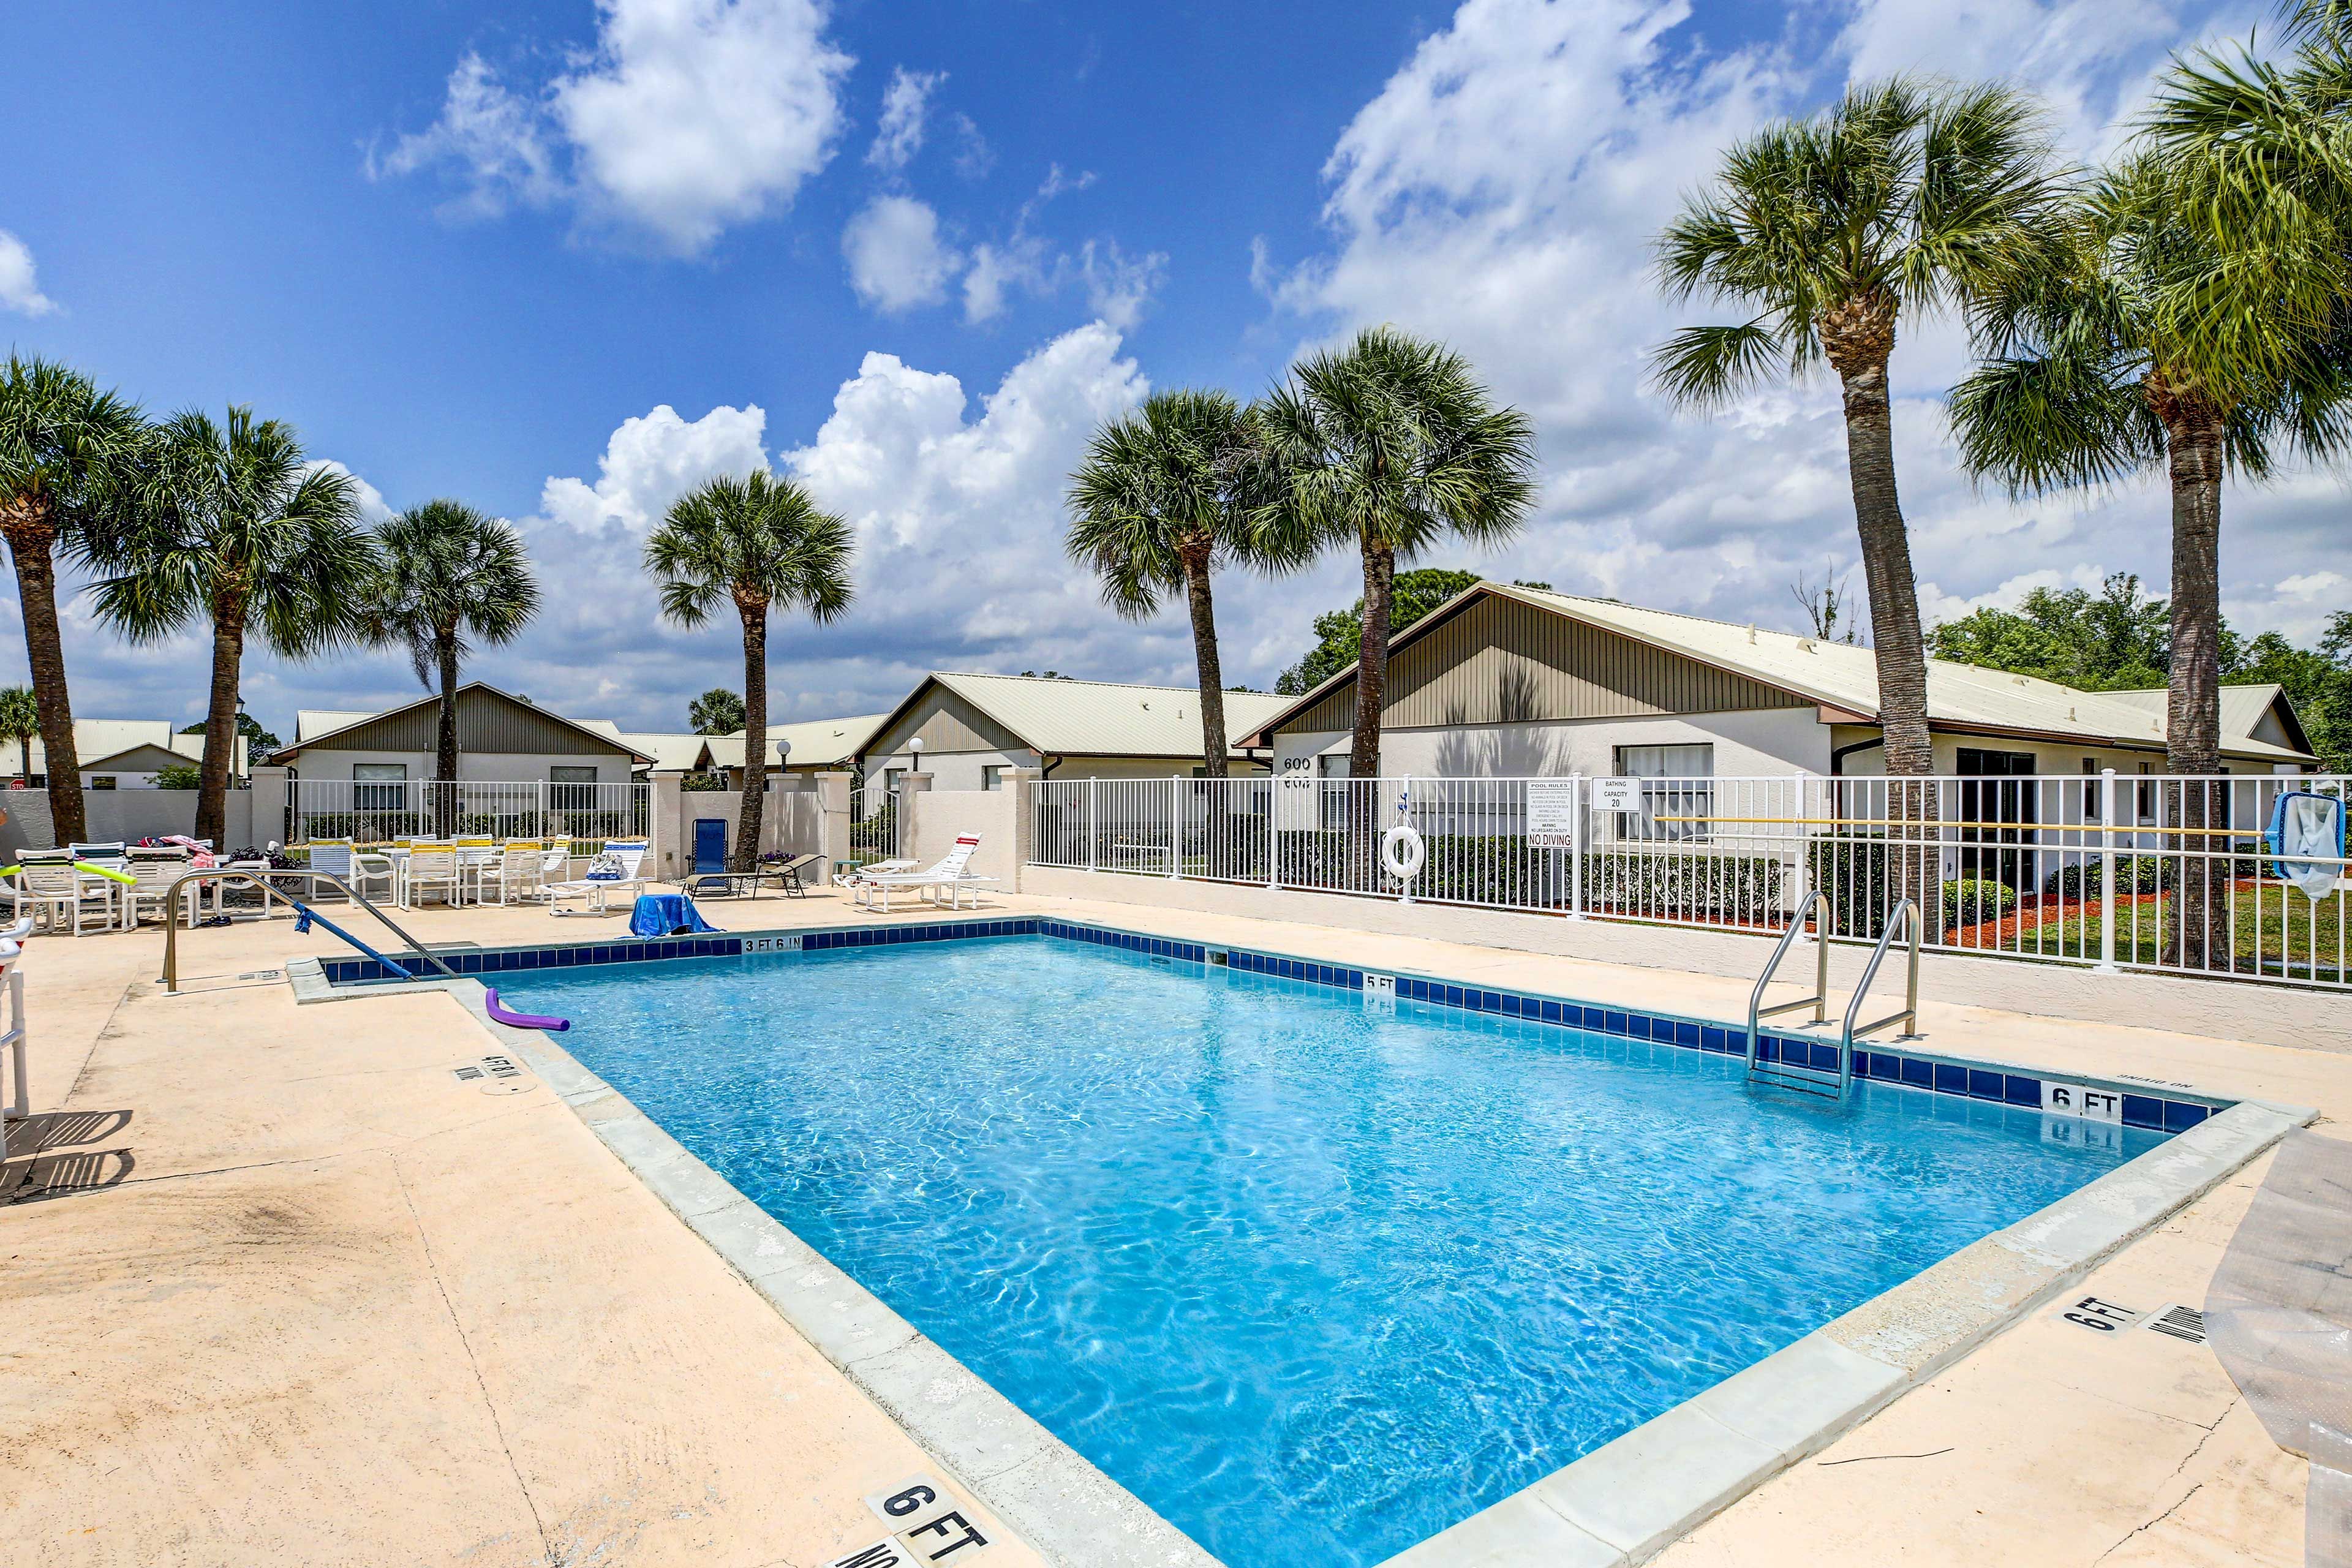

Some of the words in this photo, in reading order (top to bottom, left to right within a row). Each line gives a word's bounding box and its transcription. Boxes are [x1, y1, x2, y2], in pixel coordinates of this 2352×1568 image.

[1284, 758, 1310, 769] 600
[1529, 834, 1540, 845] NO
[1544, 834, 1570, 845] DIVING
[746, 940, 753, 951] 3
[759, 939, 771, 951] FT
[777, 938, 783, 949] 6
[790, 937, 800, 949] IN
[1368, 976, 1374, 988] 5
[1380, 978, 1393, 990] FT
[2053, 1088, 2070, 1110] 6
[2085, 1092, 2117, 1118] FT
[2075, 1297, 2135, 1321] FT
[2064, 1313, 2115, 1331] 6
[884, 1485, 936, 1516] 6
[908, 1510, 989, 1561] FT
